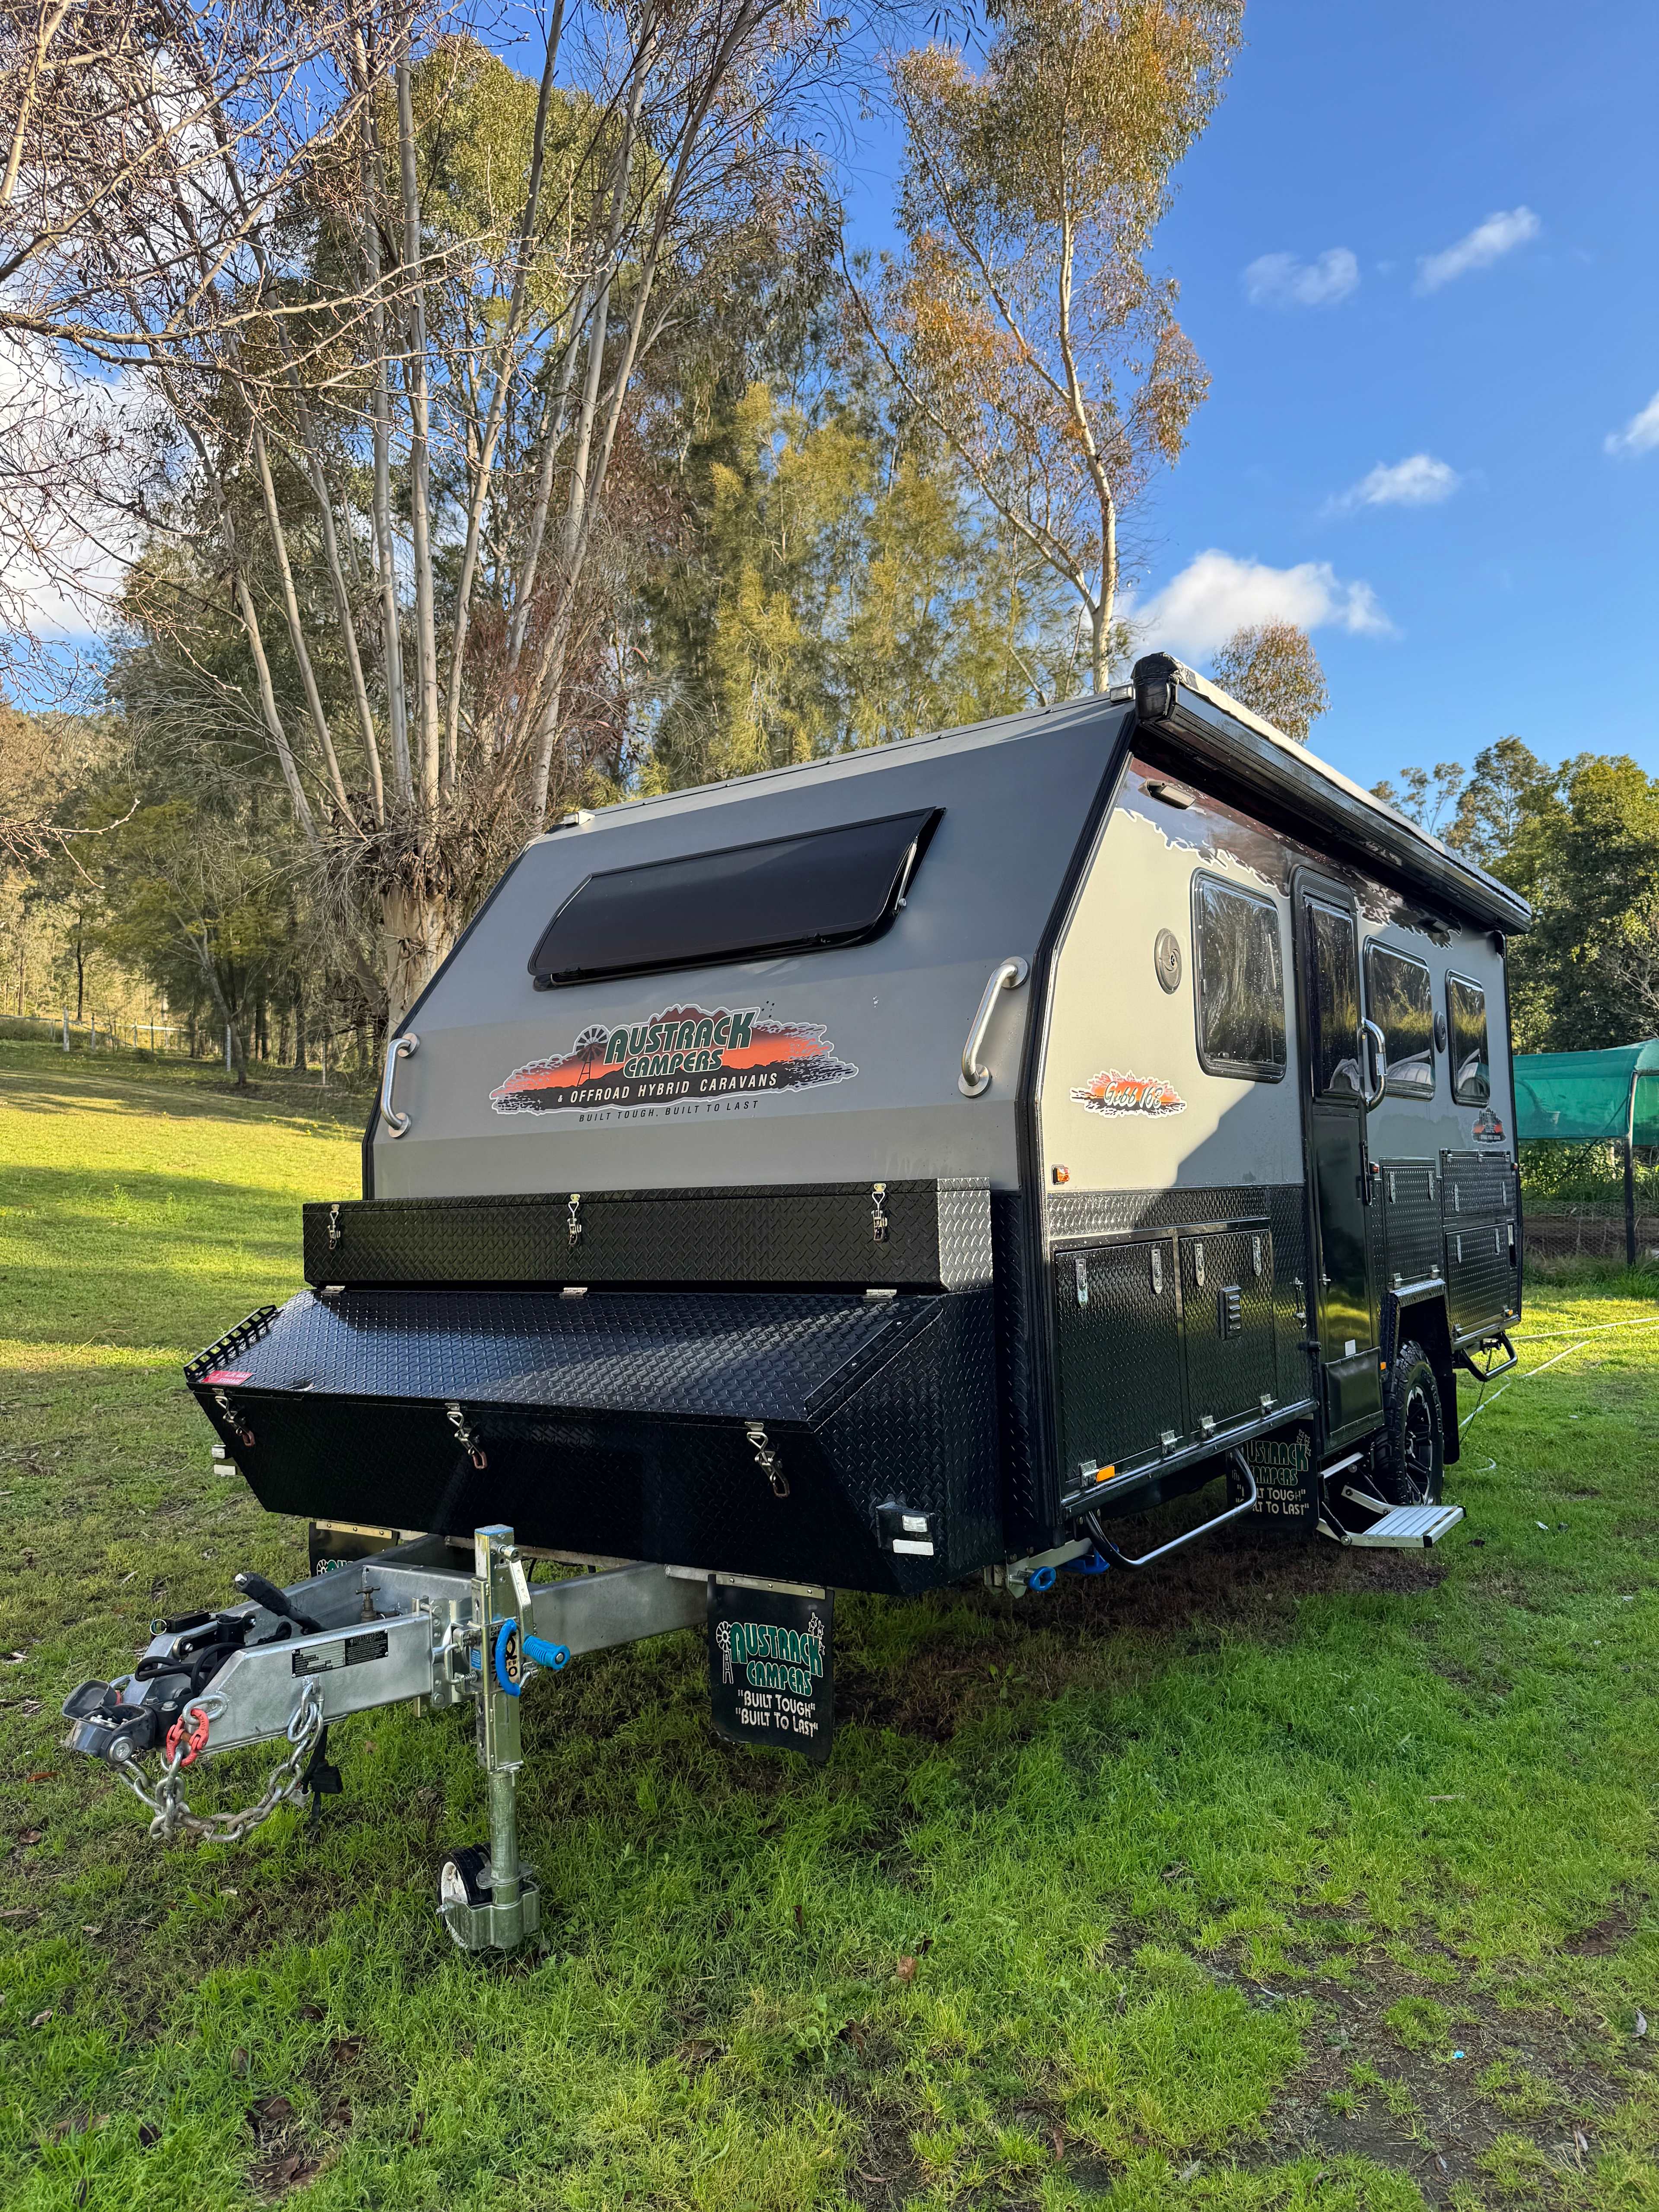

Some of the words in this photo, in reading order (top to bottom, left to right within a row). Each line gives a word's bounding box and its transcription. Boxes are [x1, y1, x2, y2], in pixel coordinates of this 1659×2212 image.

[604, 1011, 758, 1065] AUSTRACK
[623, 1049, 723, 1079] CAMPERS
[557, 1094, 563, 1103] &
[570, 1086, 629, 1103] OFFROAD
[638, 1081, 690, 1098] HYBRID
[699, 1073, 778, 1092] CARAVANS
[1104, 1081, 1138, 1107] Gibb
[578, 1112, 611, 1122] BUILT
[665, 1104, 699, 1116] BUILT
[705, 1103, 721, 1113] TO
[727, 1101, 759, 1111] LAST
[1242, 1440, 1308, 1471] USTRACK
[1266, 1501, 1279, 1514] TO
[1283, 1502, 1309, 1515] LAST"
[1267, 1487, 1306, 1501] TOUGH"
[731, 1622, 823, 1677] AUSTRACK
[747, 1661, 813, 1697] CAMPERS
[737, 1689, 772, 1709] "BUILT
[776, 1694, 815, 1718] TOUGH"
[735, 1707, 770, 1726] "BUILT
[774, 1712, 789, 1730] TO
